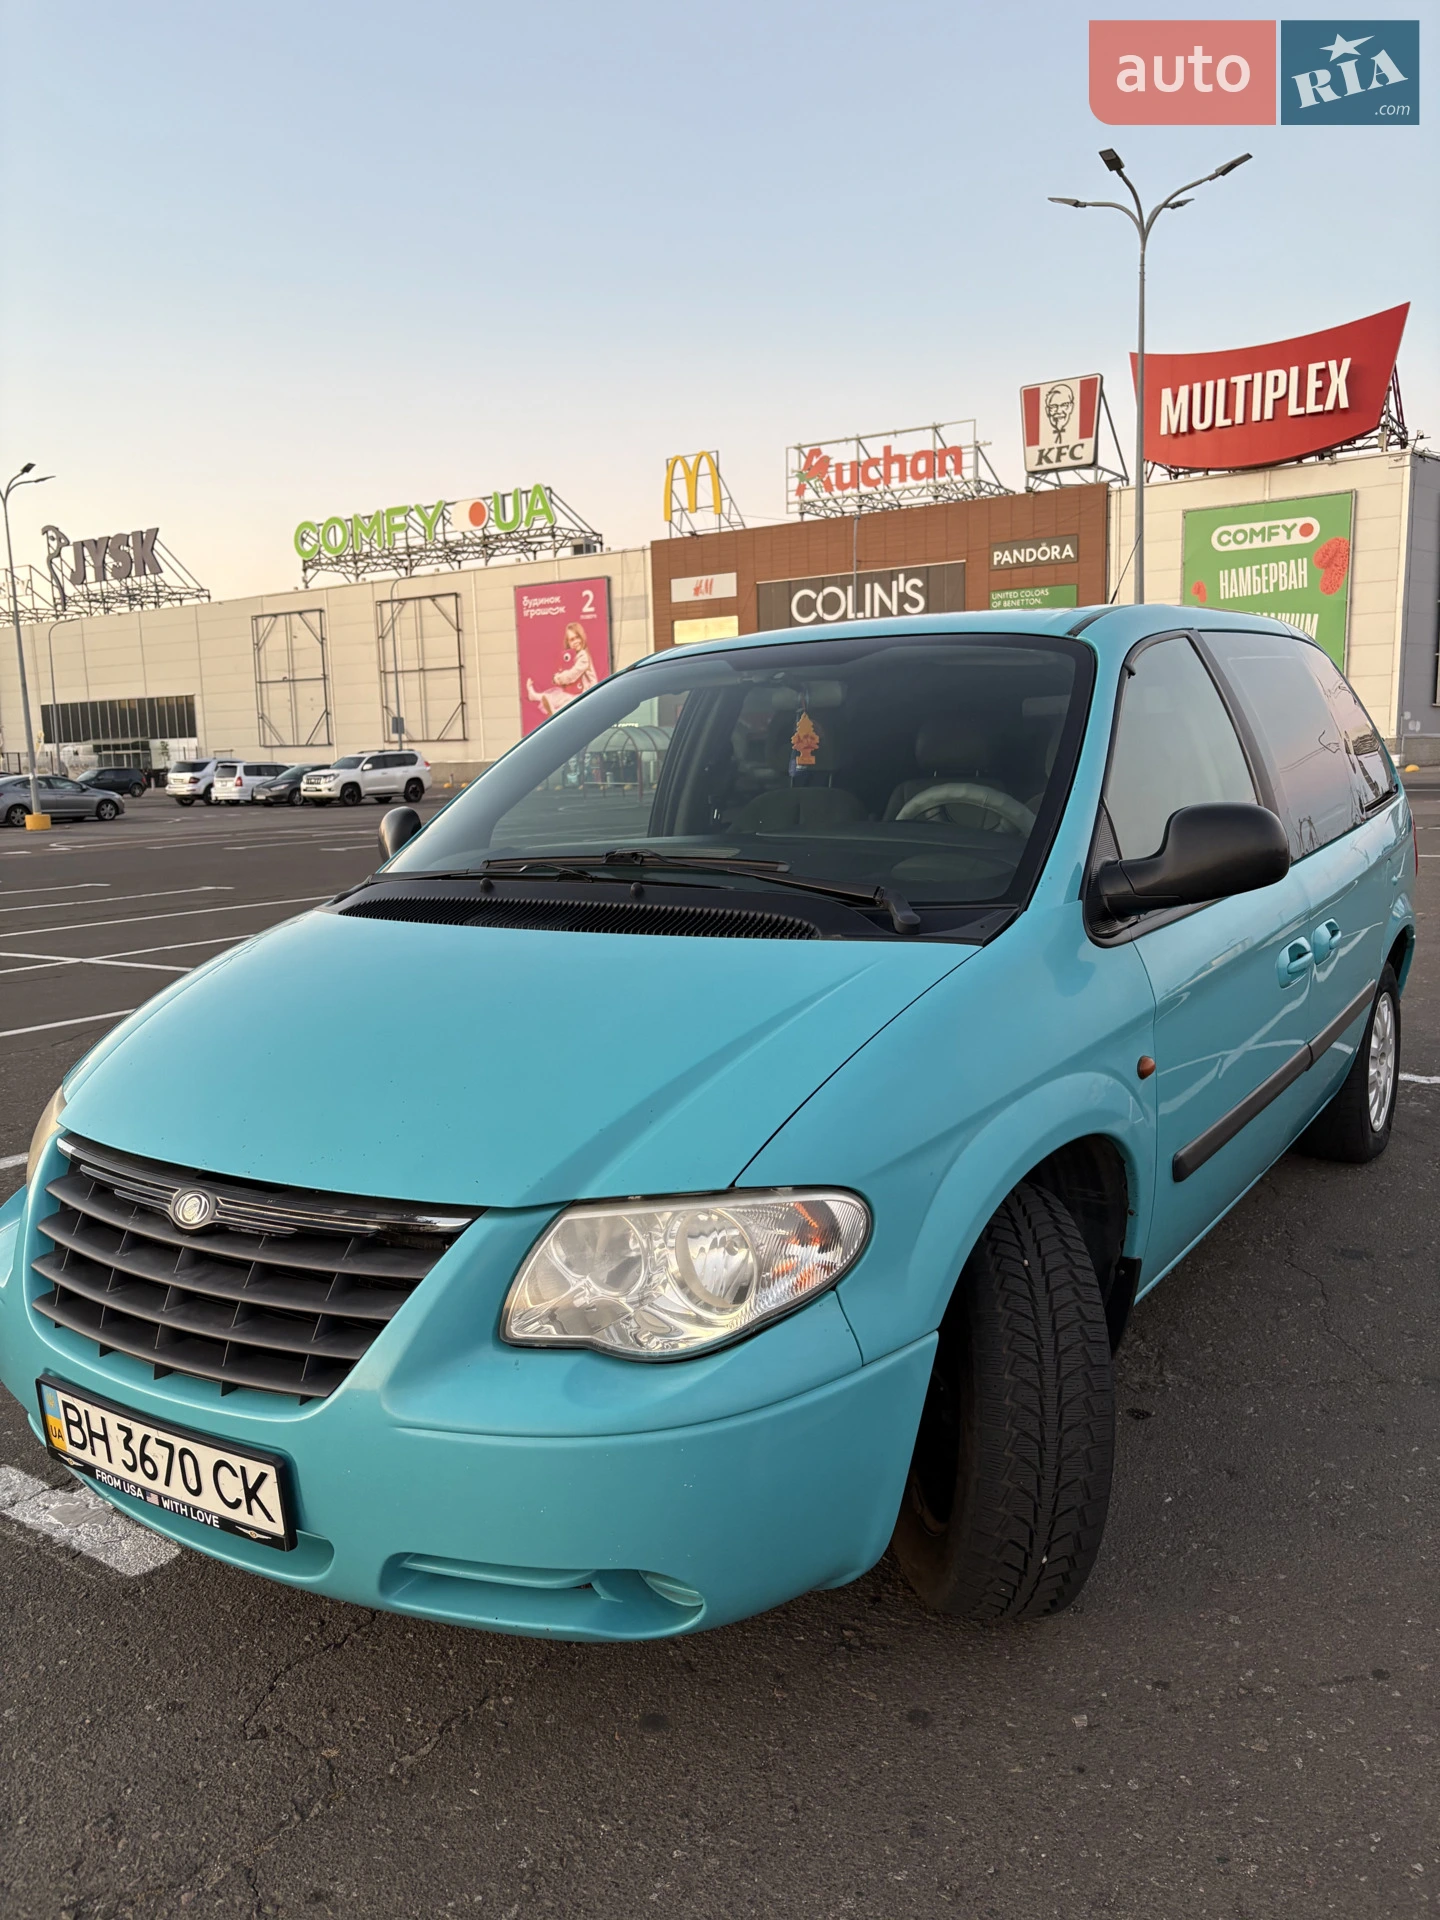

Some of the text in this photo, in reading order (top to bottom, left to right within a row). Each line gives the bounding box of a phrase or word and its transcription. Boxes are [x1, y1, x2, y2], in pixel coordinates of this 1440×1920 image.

[1159, 357, 1352, 436] MULTIPLEX
[794, 444, 963, 497] Auchan
[1035, 443, 1085, 466] KFC
[293, 483, 557, 560] COMFY UA
[1216, 522, 1298, 547] COMFY
[69, 527, 163, 586] JYSK
[993, 543, 1075, 566] PANDORA
[582, 589, 596, 613] 2
[790, 573, 926, 624] COLIN'S
[991, 588, 1050, 600] UNITED COLORS
[1219, 557, 1308, 600] НАМБЕРВАН
[50, 1424, 65, 1442] UA
[62, 1399, 277, 1524] BH 3670 CK
[95, 1468, 221, 1529] FROM USA WITH LOVE
